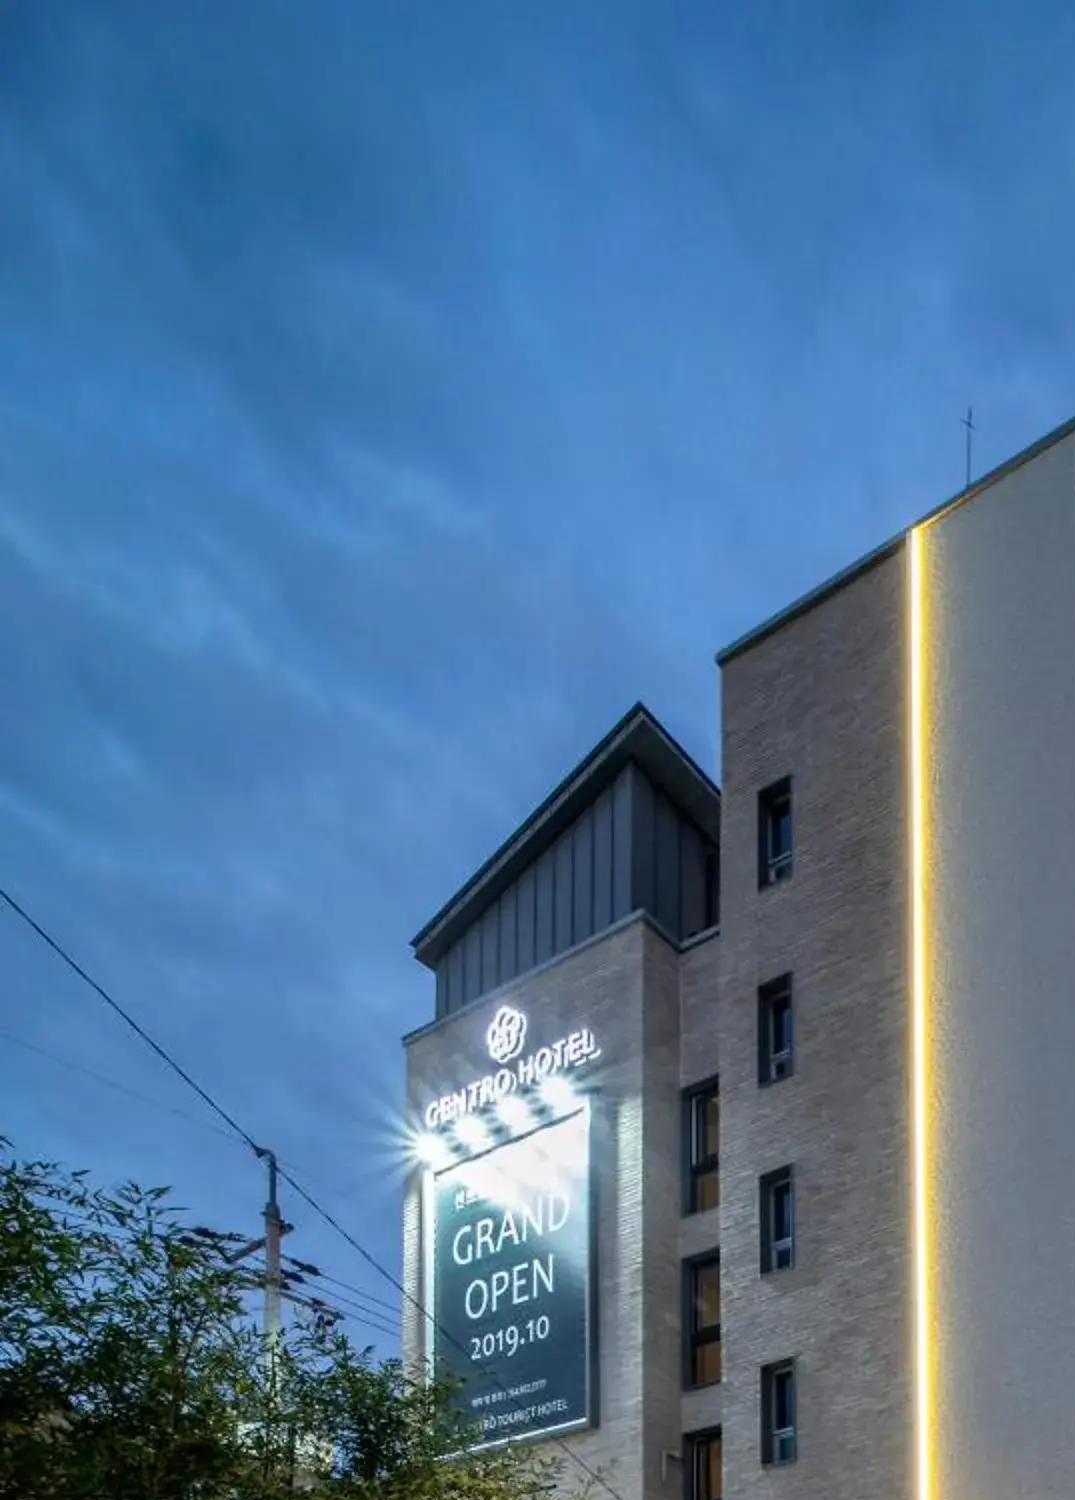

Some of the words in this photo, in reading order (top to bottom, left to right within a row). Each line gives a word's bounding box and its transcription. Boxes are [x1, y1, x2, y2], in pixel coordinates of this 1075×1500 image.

[426, 1068, 517, 1127] CENTRO
[518, 1029, 601, 1085] HOTEL
[452, 1193, 570, 1265] GRAND
[465, 1254, 554, 1319] OPEN
[470, 1315, 550, 1360] 2019.10
[538, 1399, 568, 1416] HOTEL
